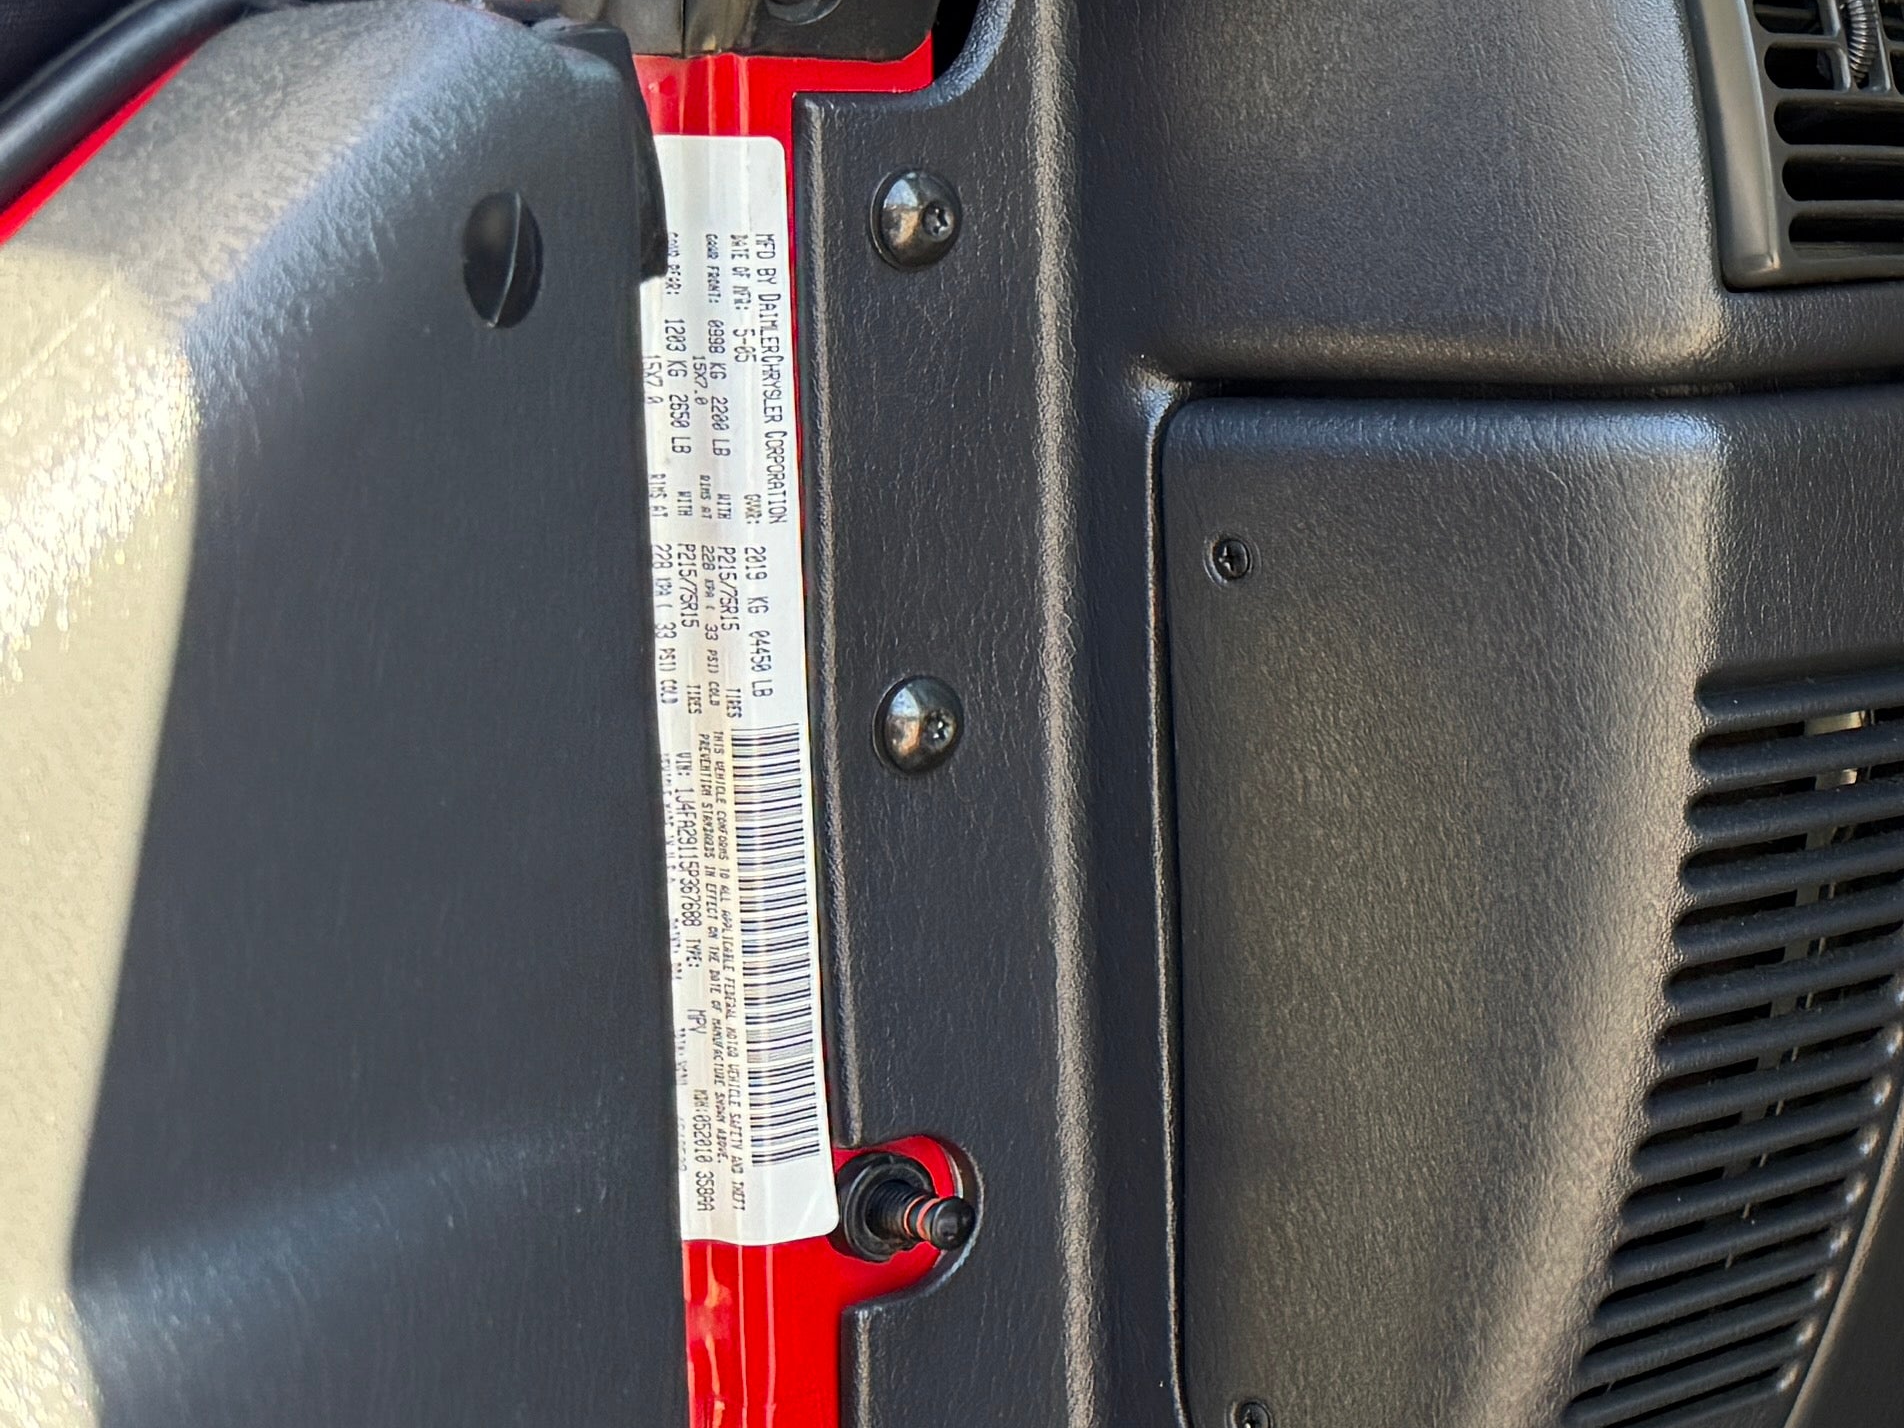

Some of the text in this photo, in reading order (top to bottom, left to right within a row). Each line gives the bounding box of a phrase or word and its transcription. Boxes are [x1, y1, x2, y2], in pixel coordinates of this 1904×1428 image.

[757, 268, 776, 284] BY
[664, 319, 686, 352] 1203
[707, 320, 725, 354] 0998
[667, 360, 686, 377] KG
[710, 363, 726, 380] KG
[669, 394, 689, 428] 2650
[711, 396, 729, 430] 2200
[671, 437, 692, 454] LB
[712, 439, 731, 456] LB
[677, 491, 692, 516] WITH
[701, 506, 712, 519] AT
[717, 494, 731, 520] WITH
[701, 545, 715, 570] 228
[744, 547, 767, 580] 2019
[677, 543, 699, 628] P215/75R15
[717, 547, 739, 631] P215/75R15
[747, 596, 768, 613] KG
[705, 623, 718, 640] 33
[749, 631, 772, 671] 04450
[686, 685, 701, 714] TIRES
[709, 681, 720, 706] COLD
[752, 680, 773, 697] LB
[726, 689, 742, 718] TIRES
[687, 1009, 707, 1034] MPV
